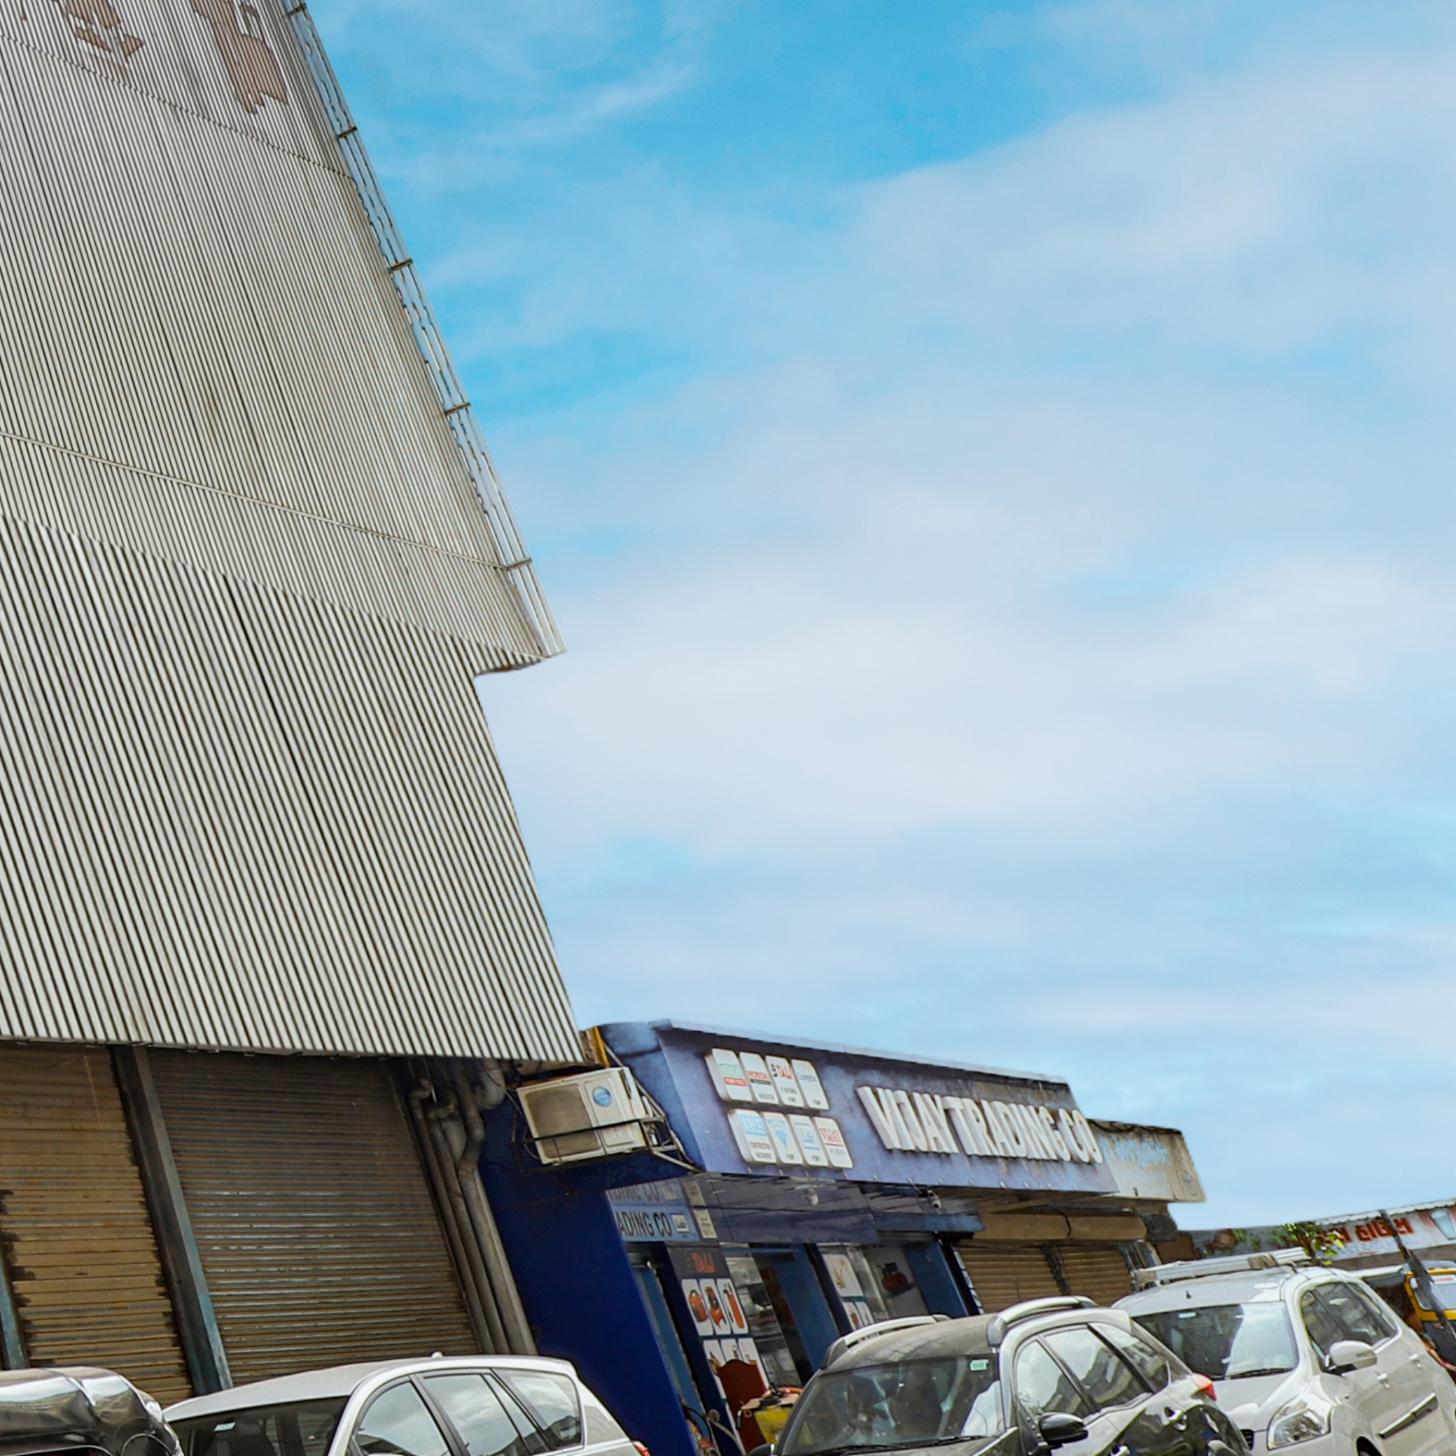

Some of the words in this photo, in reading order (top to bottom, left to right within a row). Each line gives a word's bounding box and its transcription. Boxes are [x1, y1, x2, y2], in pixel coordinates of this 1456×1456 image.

[856, 1085, 960, 1154] VIJAY
[942, 1095, 1072, 1161] TRADING
[1058, 1107, 1104, 1163] CO
